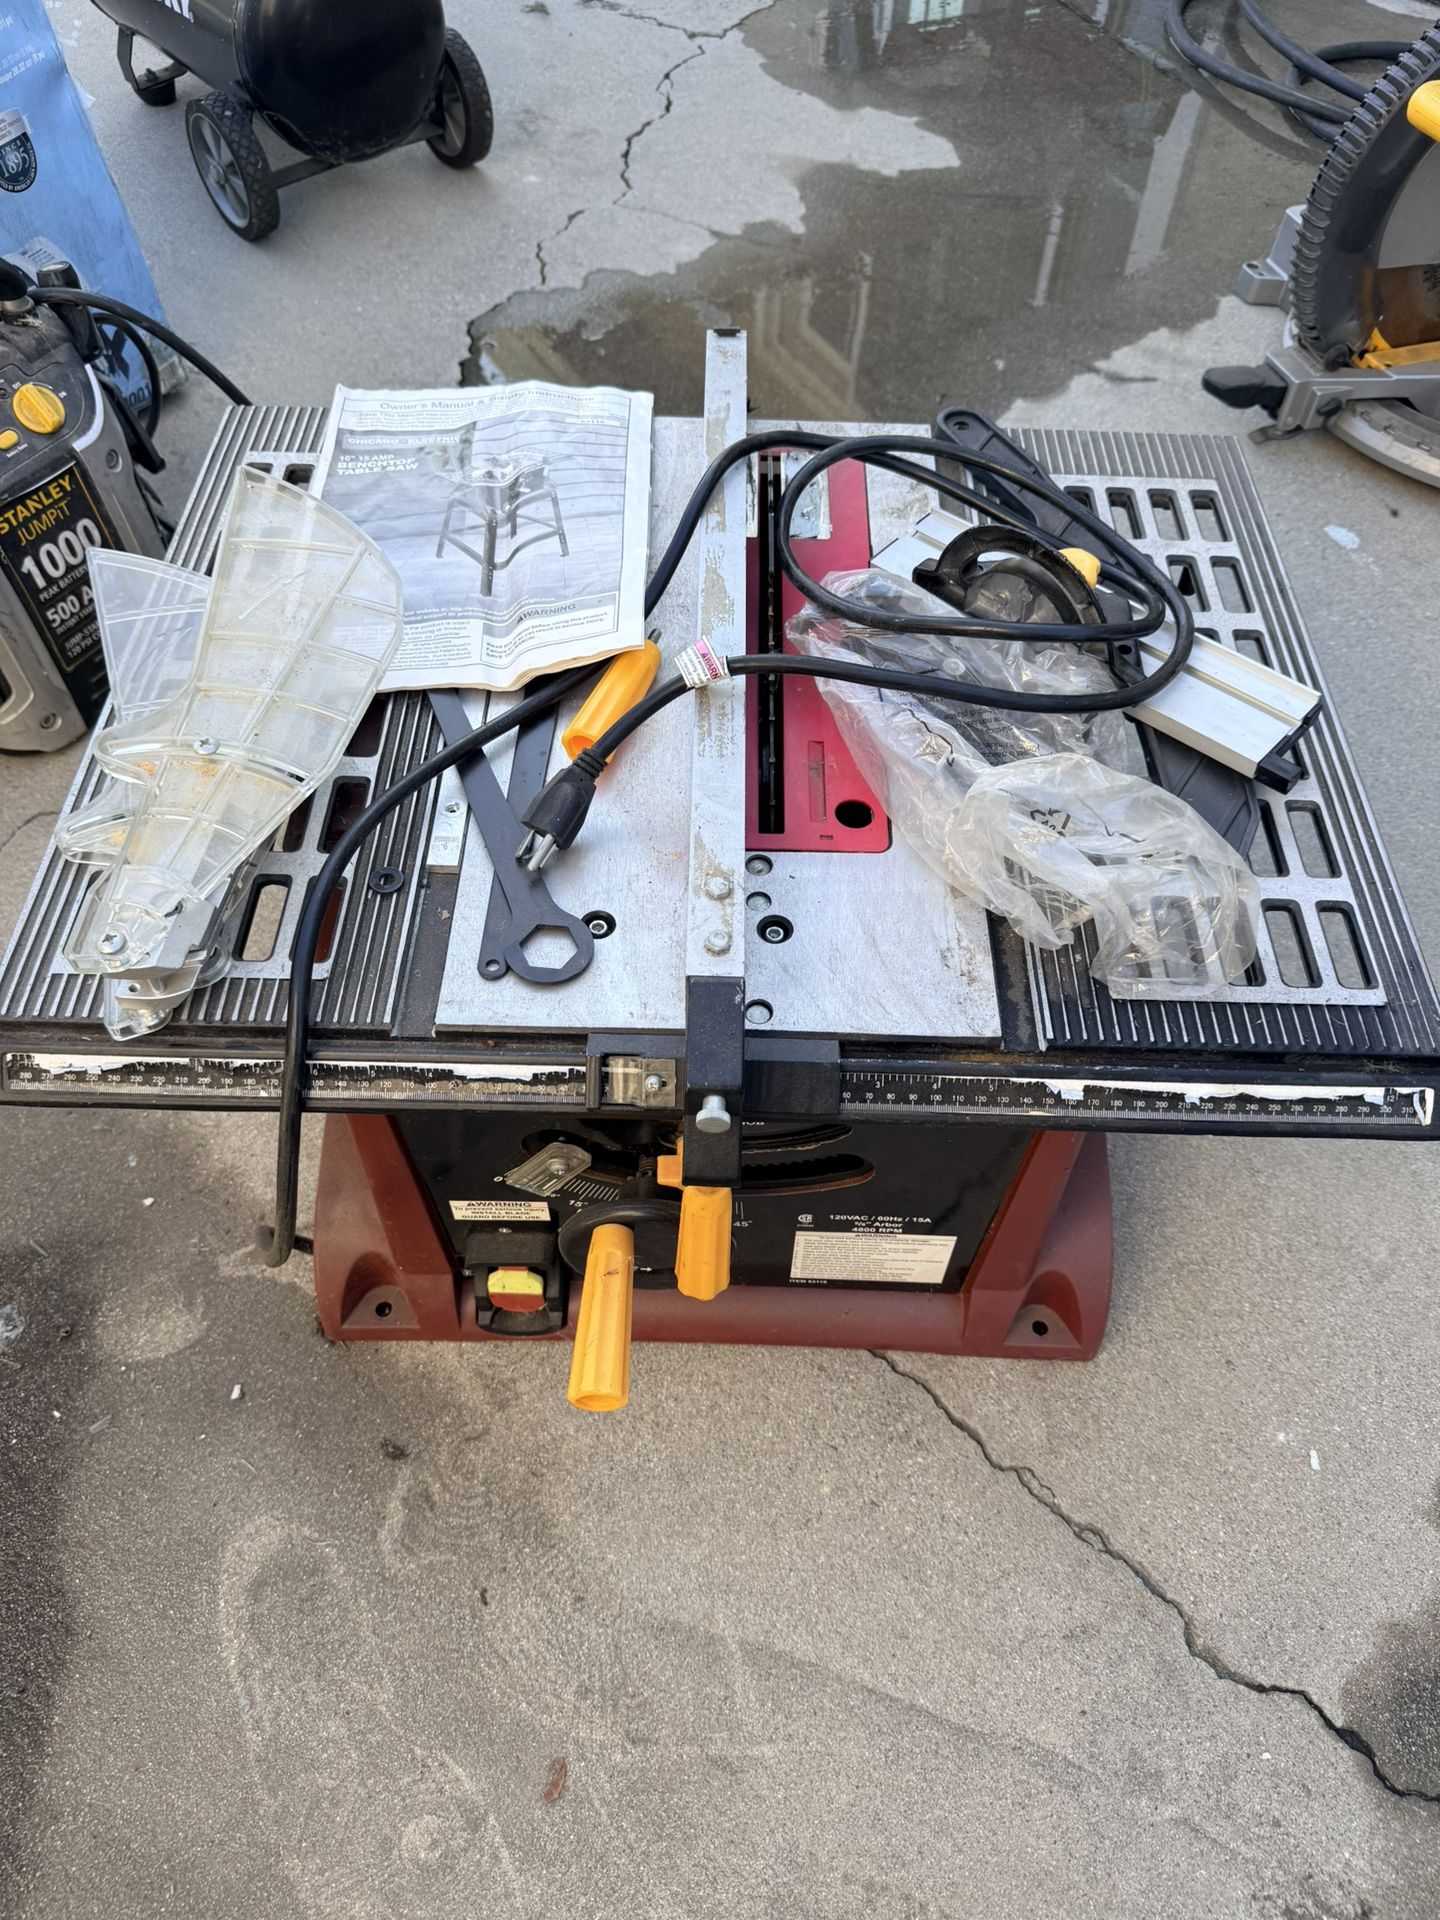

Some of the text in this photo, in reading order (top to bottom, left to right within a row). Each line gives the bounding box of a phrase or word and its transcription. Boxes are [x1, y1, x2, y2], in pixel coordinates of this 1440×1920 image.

[0, 139, 21, 156] INCE
[0, 146, 30, 178] 1895
[380, 402, 428, 411] Owner's
[431, 401, 474, 410] Manual
[337, 457, 416, 469] BENCHTOP
[372, 454, 395, 462] AMP
[336, 462, 419, 476] TABLE SAW
[0, 474, 73, 535] STANLEY
[21, 517, 102, 590] 1000
[39, 566, 89, 602] PEAK BATTERY
[46, 595, 80, 628] 500
[522, 603, 577, 620] WARNING
[41, 1072, 54, 1080] 270
[64, 1073, 77, 1081] 260
[86, 1073, 99, 1081] 250
[130, 1075, 143, 1083] 230
[244, 1078, 256, 1086] 180
[875, 1081, 881, 1089] 3
[842, 1091, 851, 1099] 60
[1065, 1098, 1077, 1106] 160
[1200, 1102, 1213, 1110] 220
